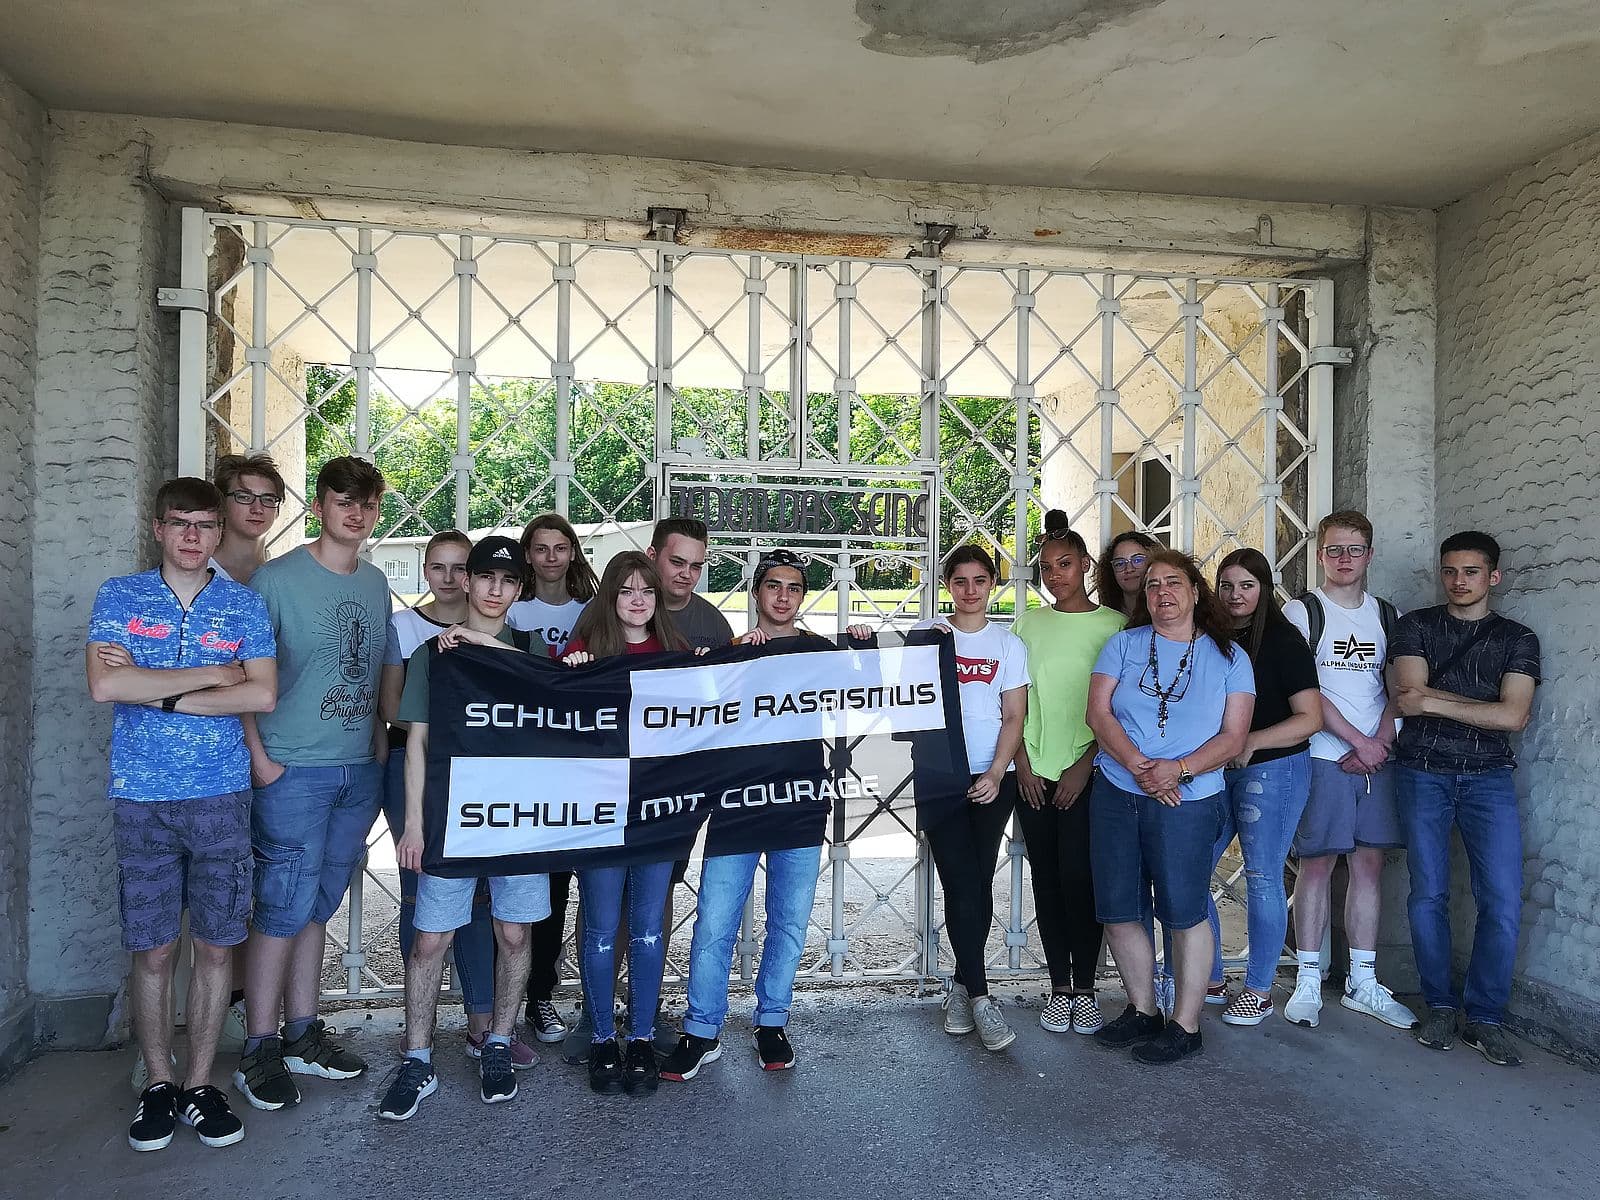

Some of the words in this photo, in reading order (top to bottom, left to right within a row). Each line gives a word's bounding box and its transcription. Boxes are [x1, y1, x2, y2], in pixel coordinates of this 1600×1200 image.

[779, 489, 839, 534] DAS
[848, 492, 929, 537] SEINE
[465, 703, 618, 731] SCHULE
[643, 701, 741, 728] OHNE
[753, 682, 937, 718] RASSISMUS
[460, 802, 617, 828] SCHULE
[640, 792, 705, 821] MIT
[720, 775, 882, 809] COURAGE
